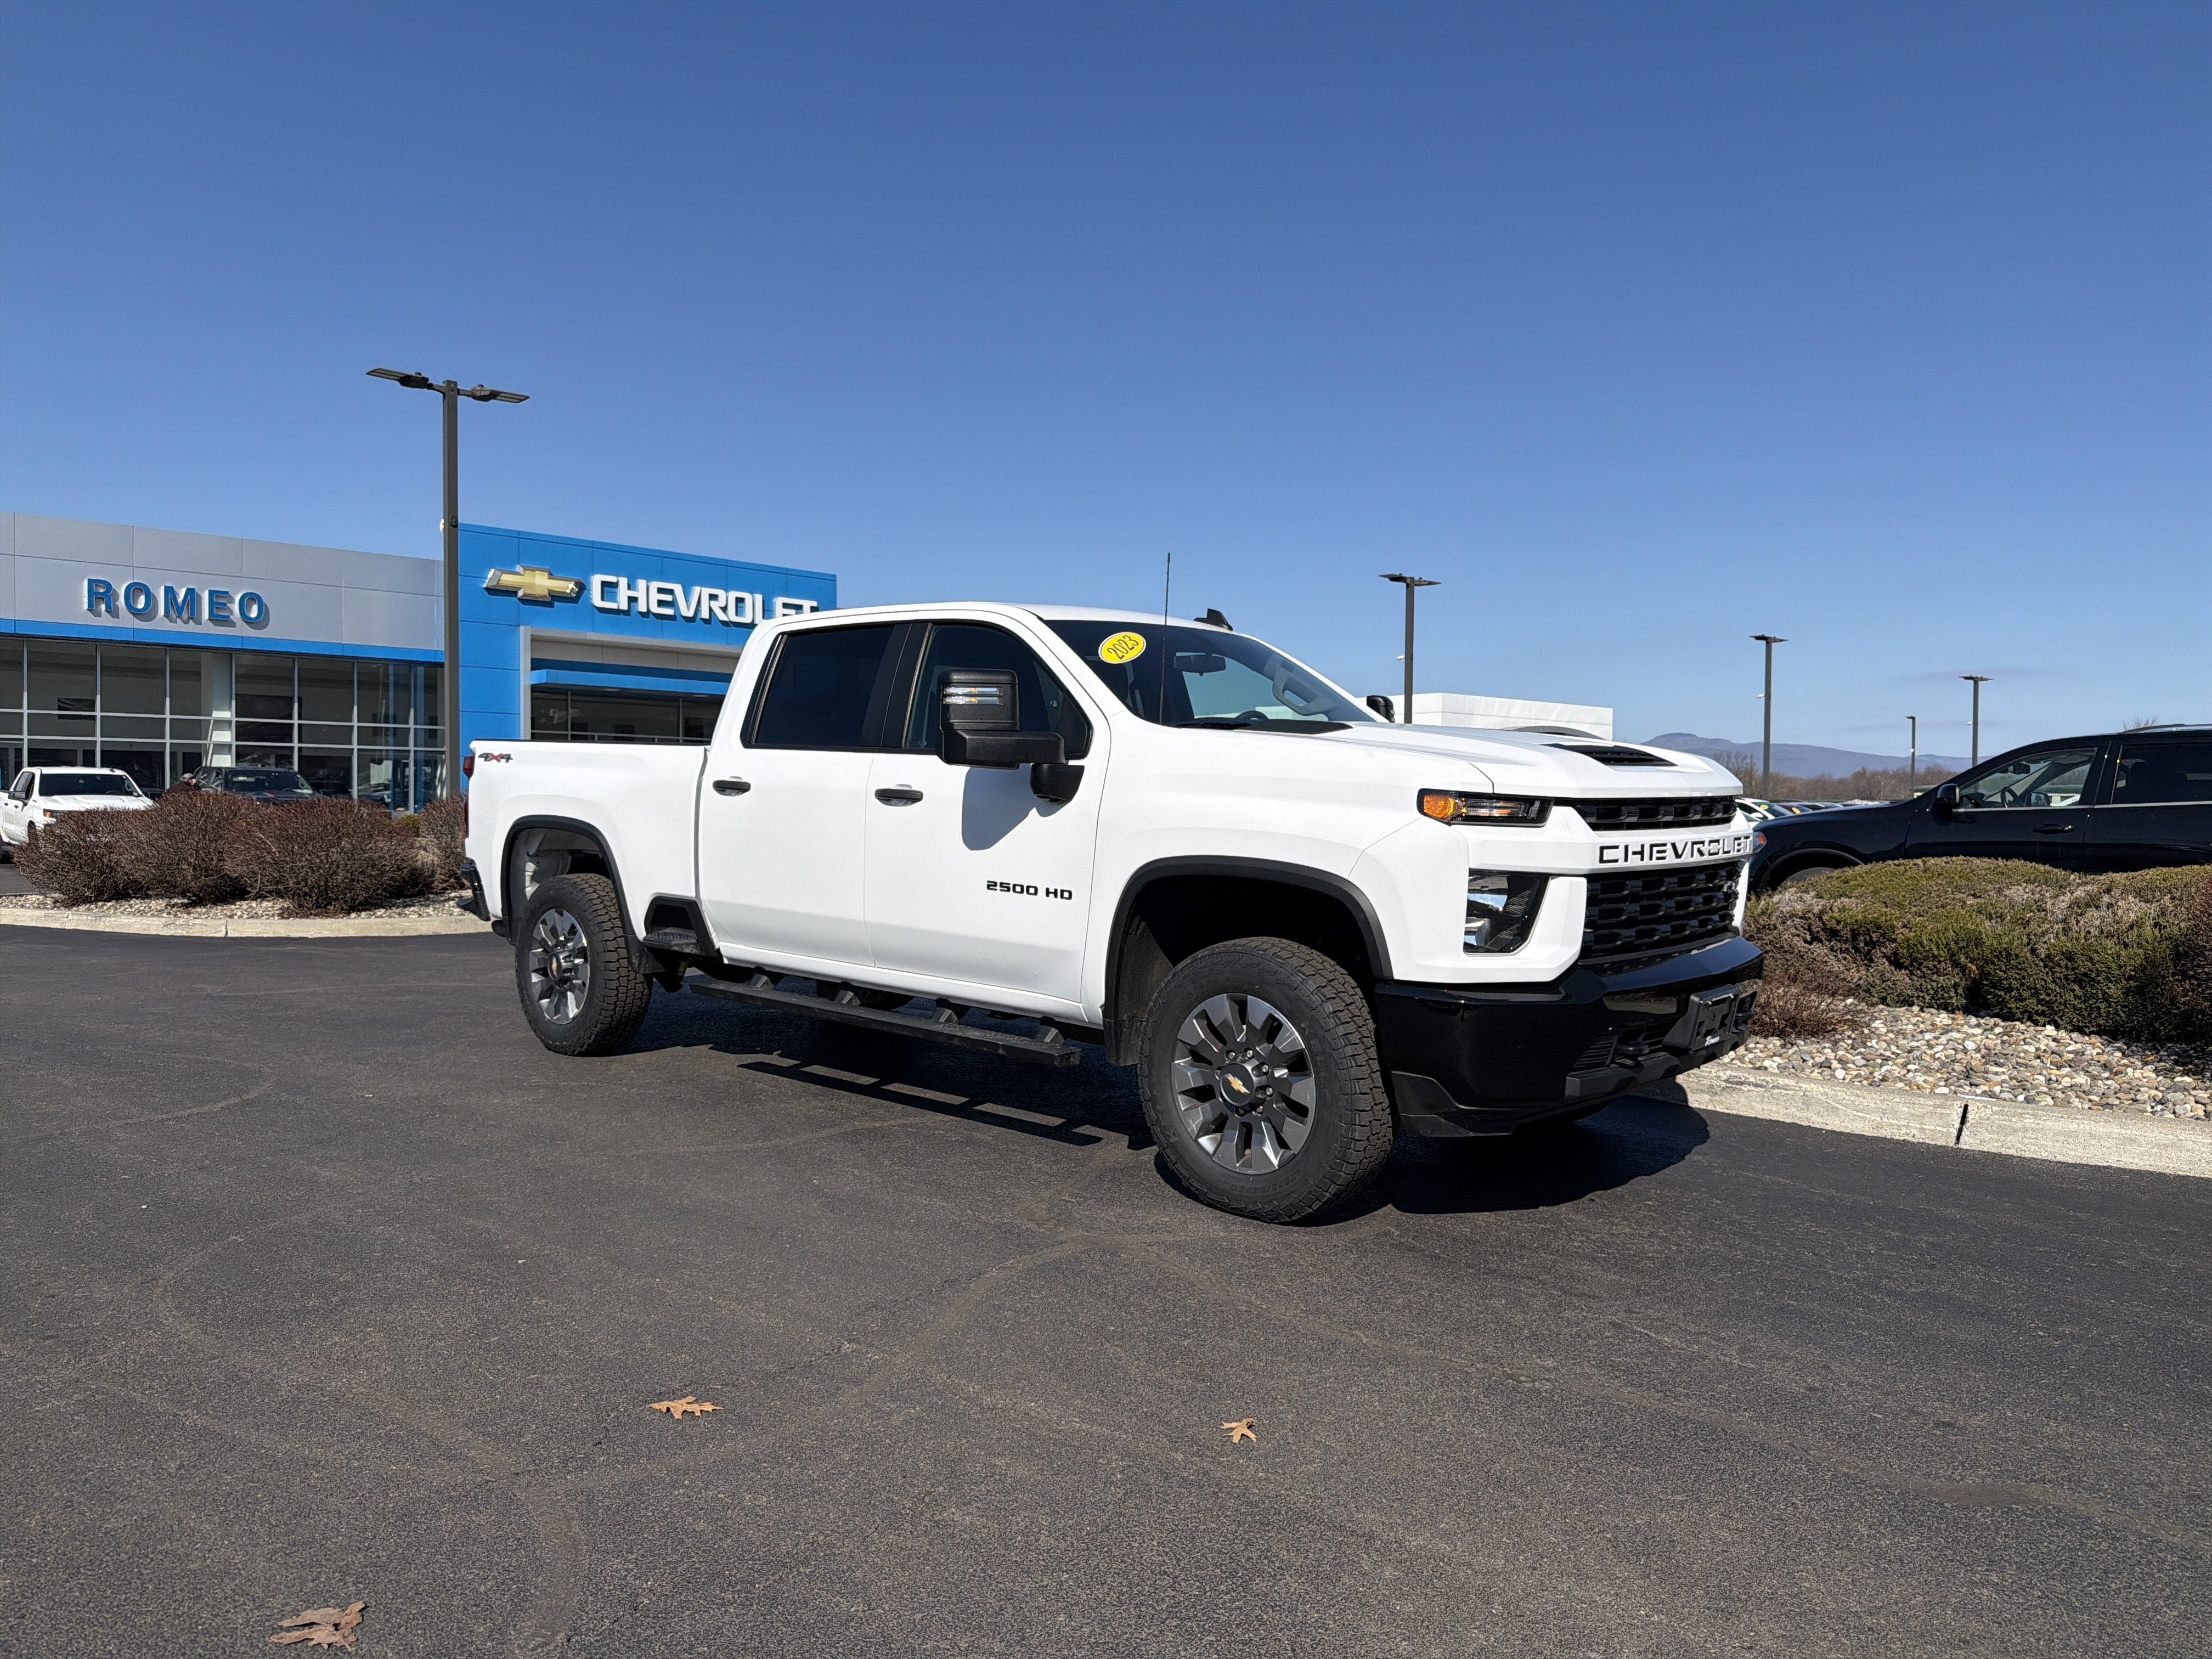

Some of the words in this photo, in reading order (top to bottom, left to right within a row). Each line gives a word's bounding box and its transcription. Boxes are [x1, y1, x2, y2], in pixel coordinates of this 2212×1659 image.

[86, 578, 265, 623] ROMEO
[1107, 635, 1139, 660] 2023
[1599, 835, 1752, 864] CHEVROLET
[986, 880, 1038, 896] 2500
[1045, 887, 1073, 901] HD
